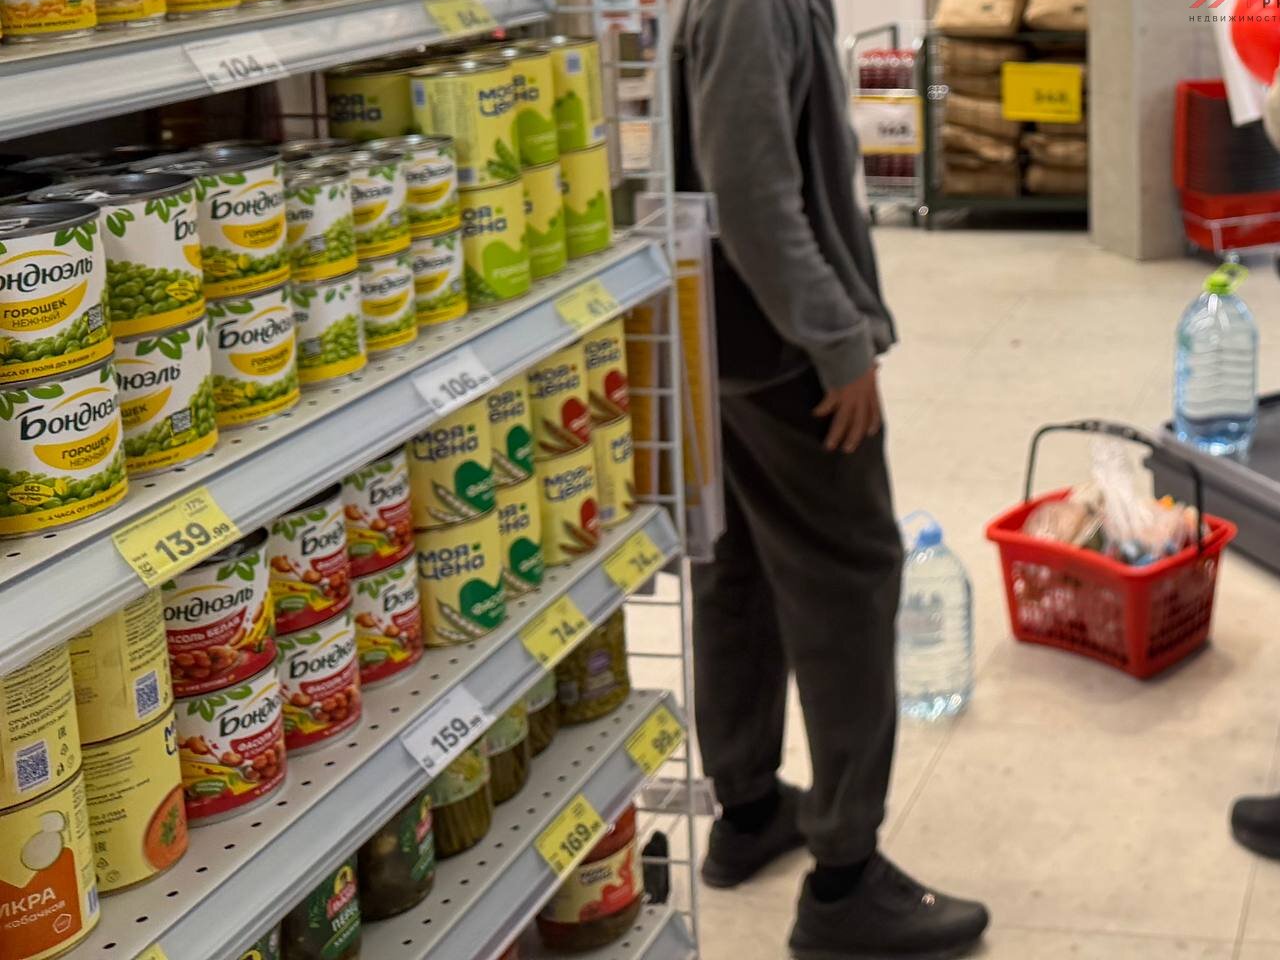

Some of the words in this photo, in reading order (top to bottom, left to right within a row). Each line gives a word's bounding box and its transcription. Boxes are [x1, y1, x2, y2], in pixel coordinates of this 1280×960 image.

[3, 298, 68, 319] ГОРОШЕК
[12, 311, 61, 328] НЕЖНЫЙ
[439, 371, 477, 400] 106
[61, 432, 112, 460] ГОРОШЕК
[163, 587, 254, 623] ондюэль
[206, 616, 240, 638] БЕЛАЯ
[431, 717, 470, 754] 159
[560, 823, 593, 858] 169
